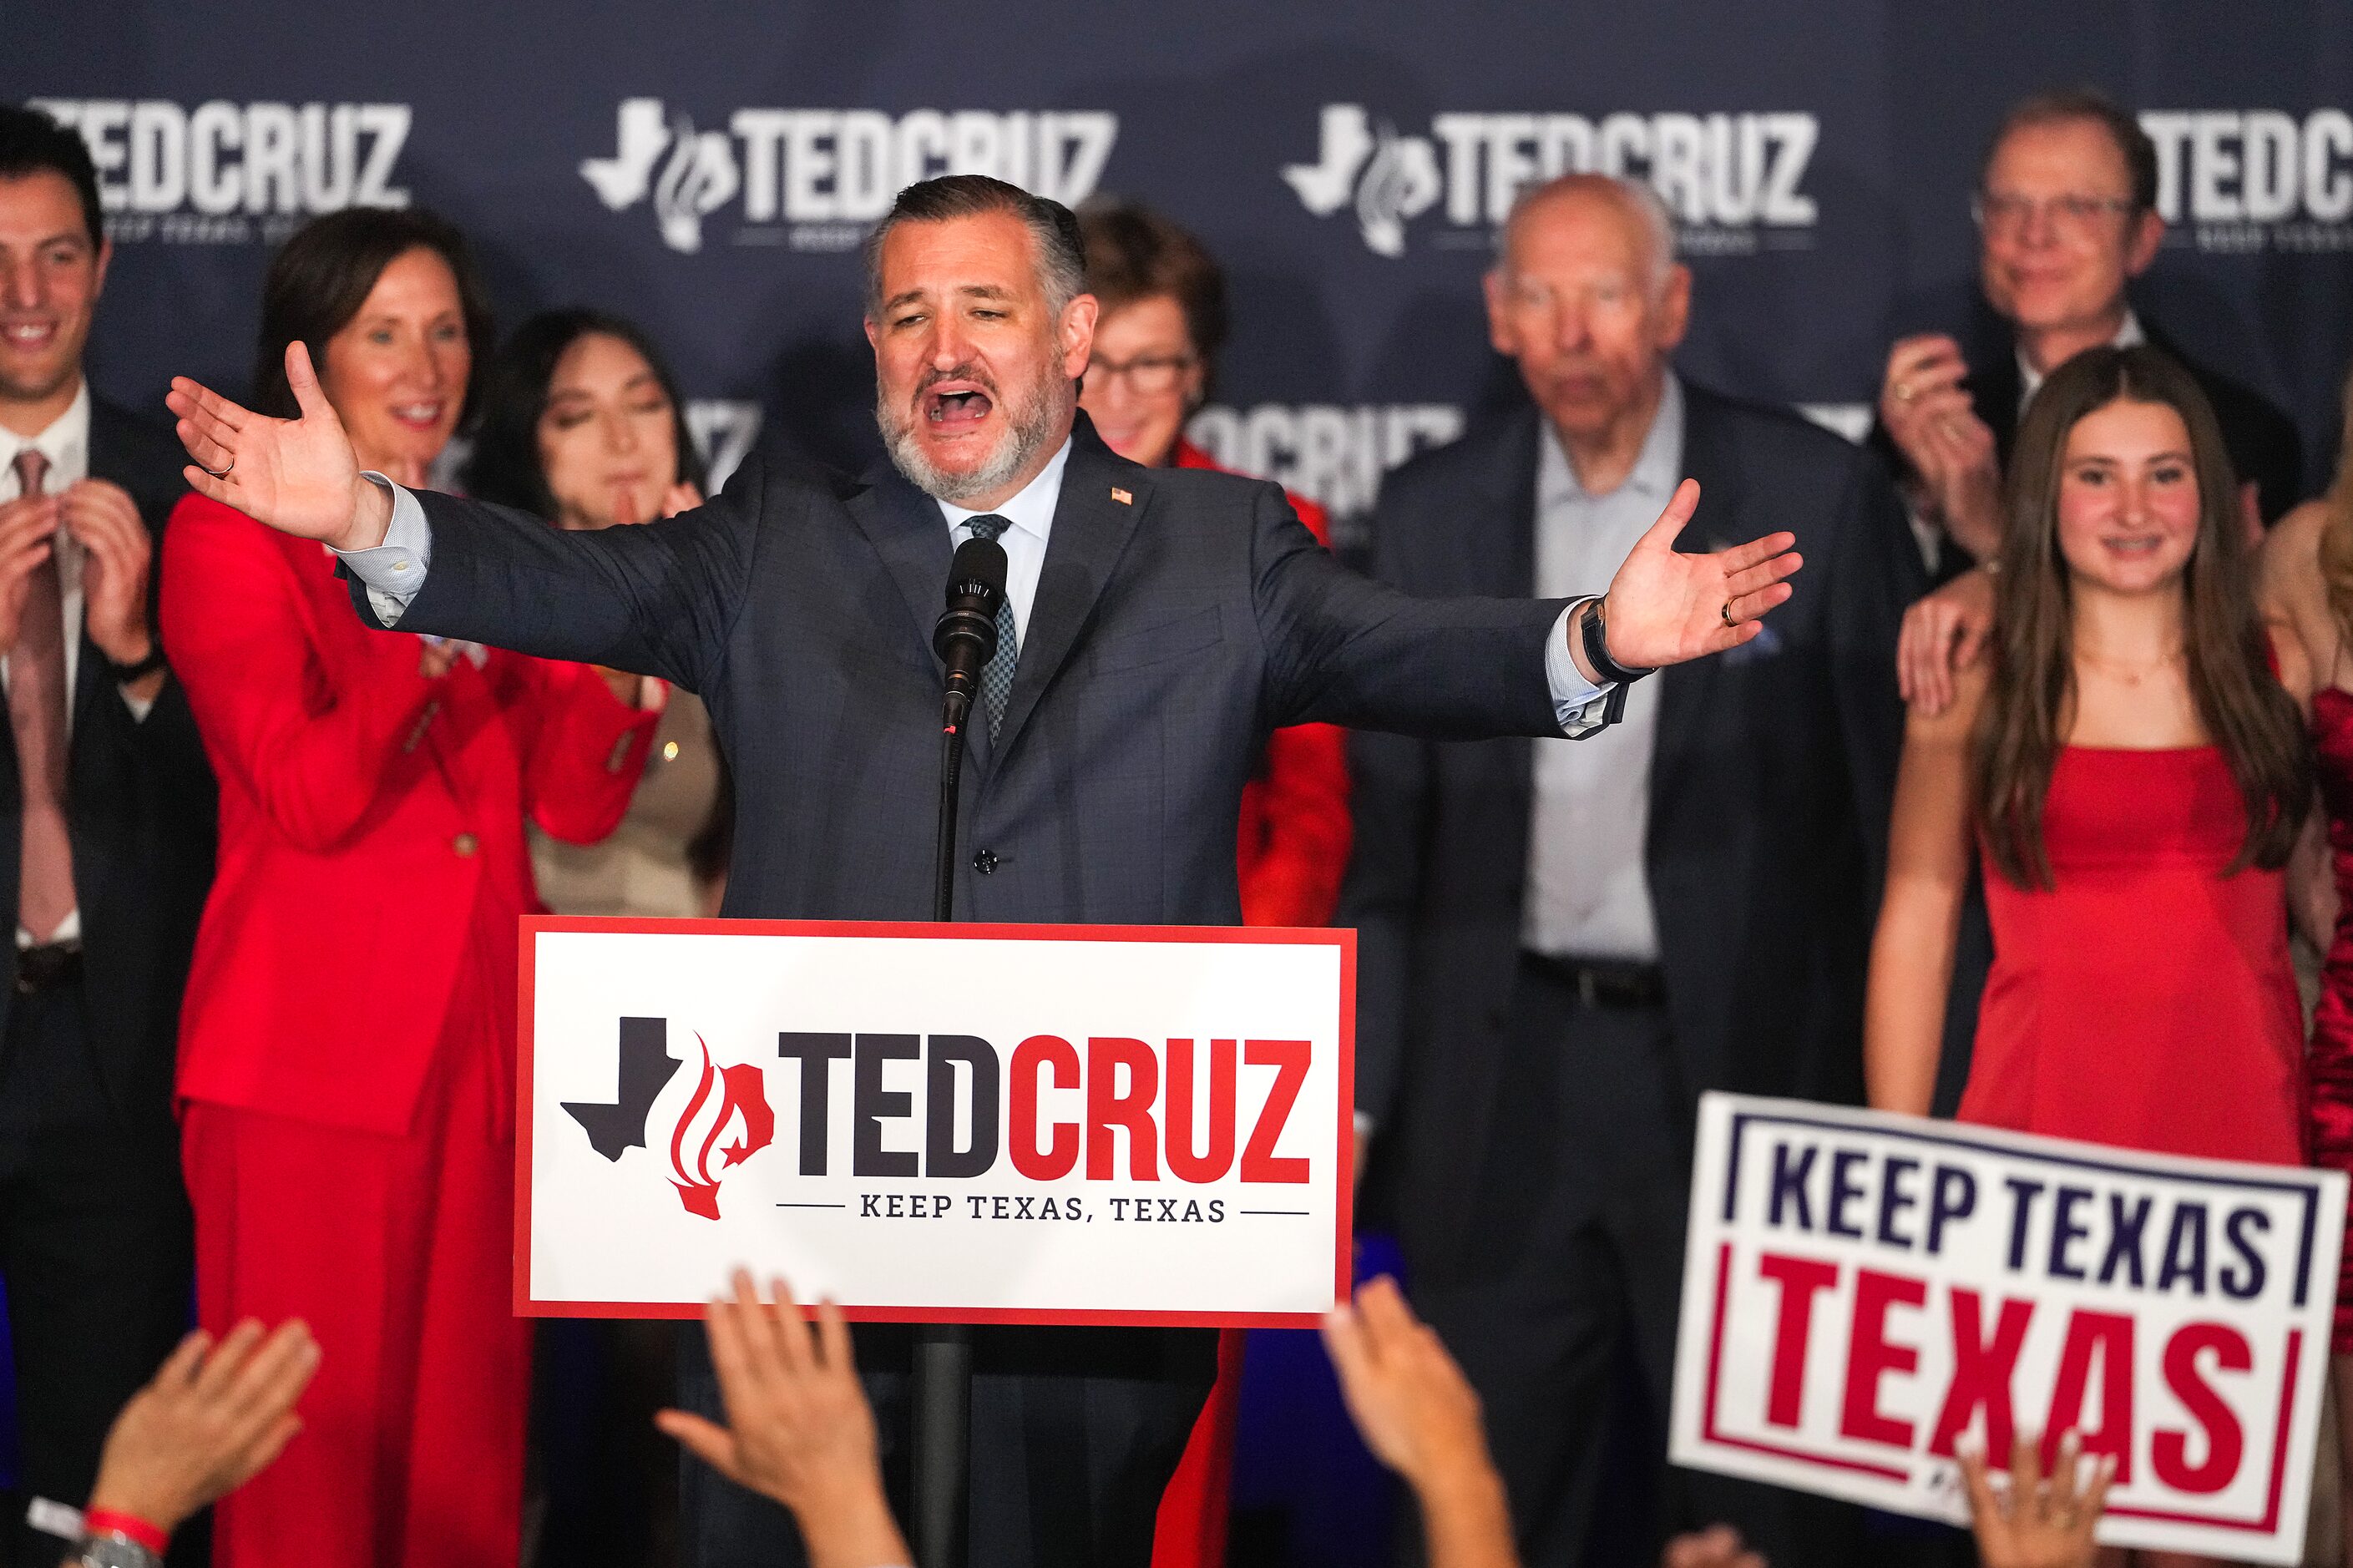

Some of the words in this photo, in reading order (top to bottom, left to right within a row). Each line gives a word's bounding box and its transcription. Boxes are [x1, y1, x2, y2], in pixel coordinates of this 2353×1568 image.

[860, 1194, 953, 1219] KEEP
[967, 1196, 1094, 1225] TEXAS,
[1109, 1198, 1226, 1223] TEXAS
[1767, 1142, 1978, 1255] KEEP
[2004, 1176, 2272, 1301] TEXAS
[1757, 1251, 2254, 1496] TEXAS
